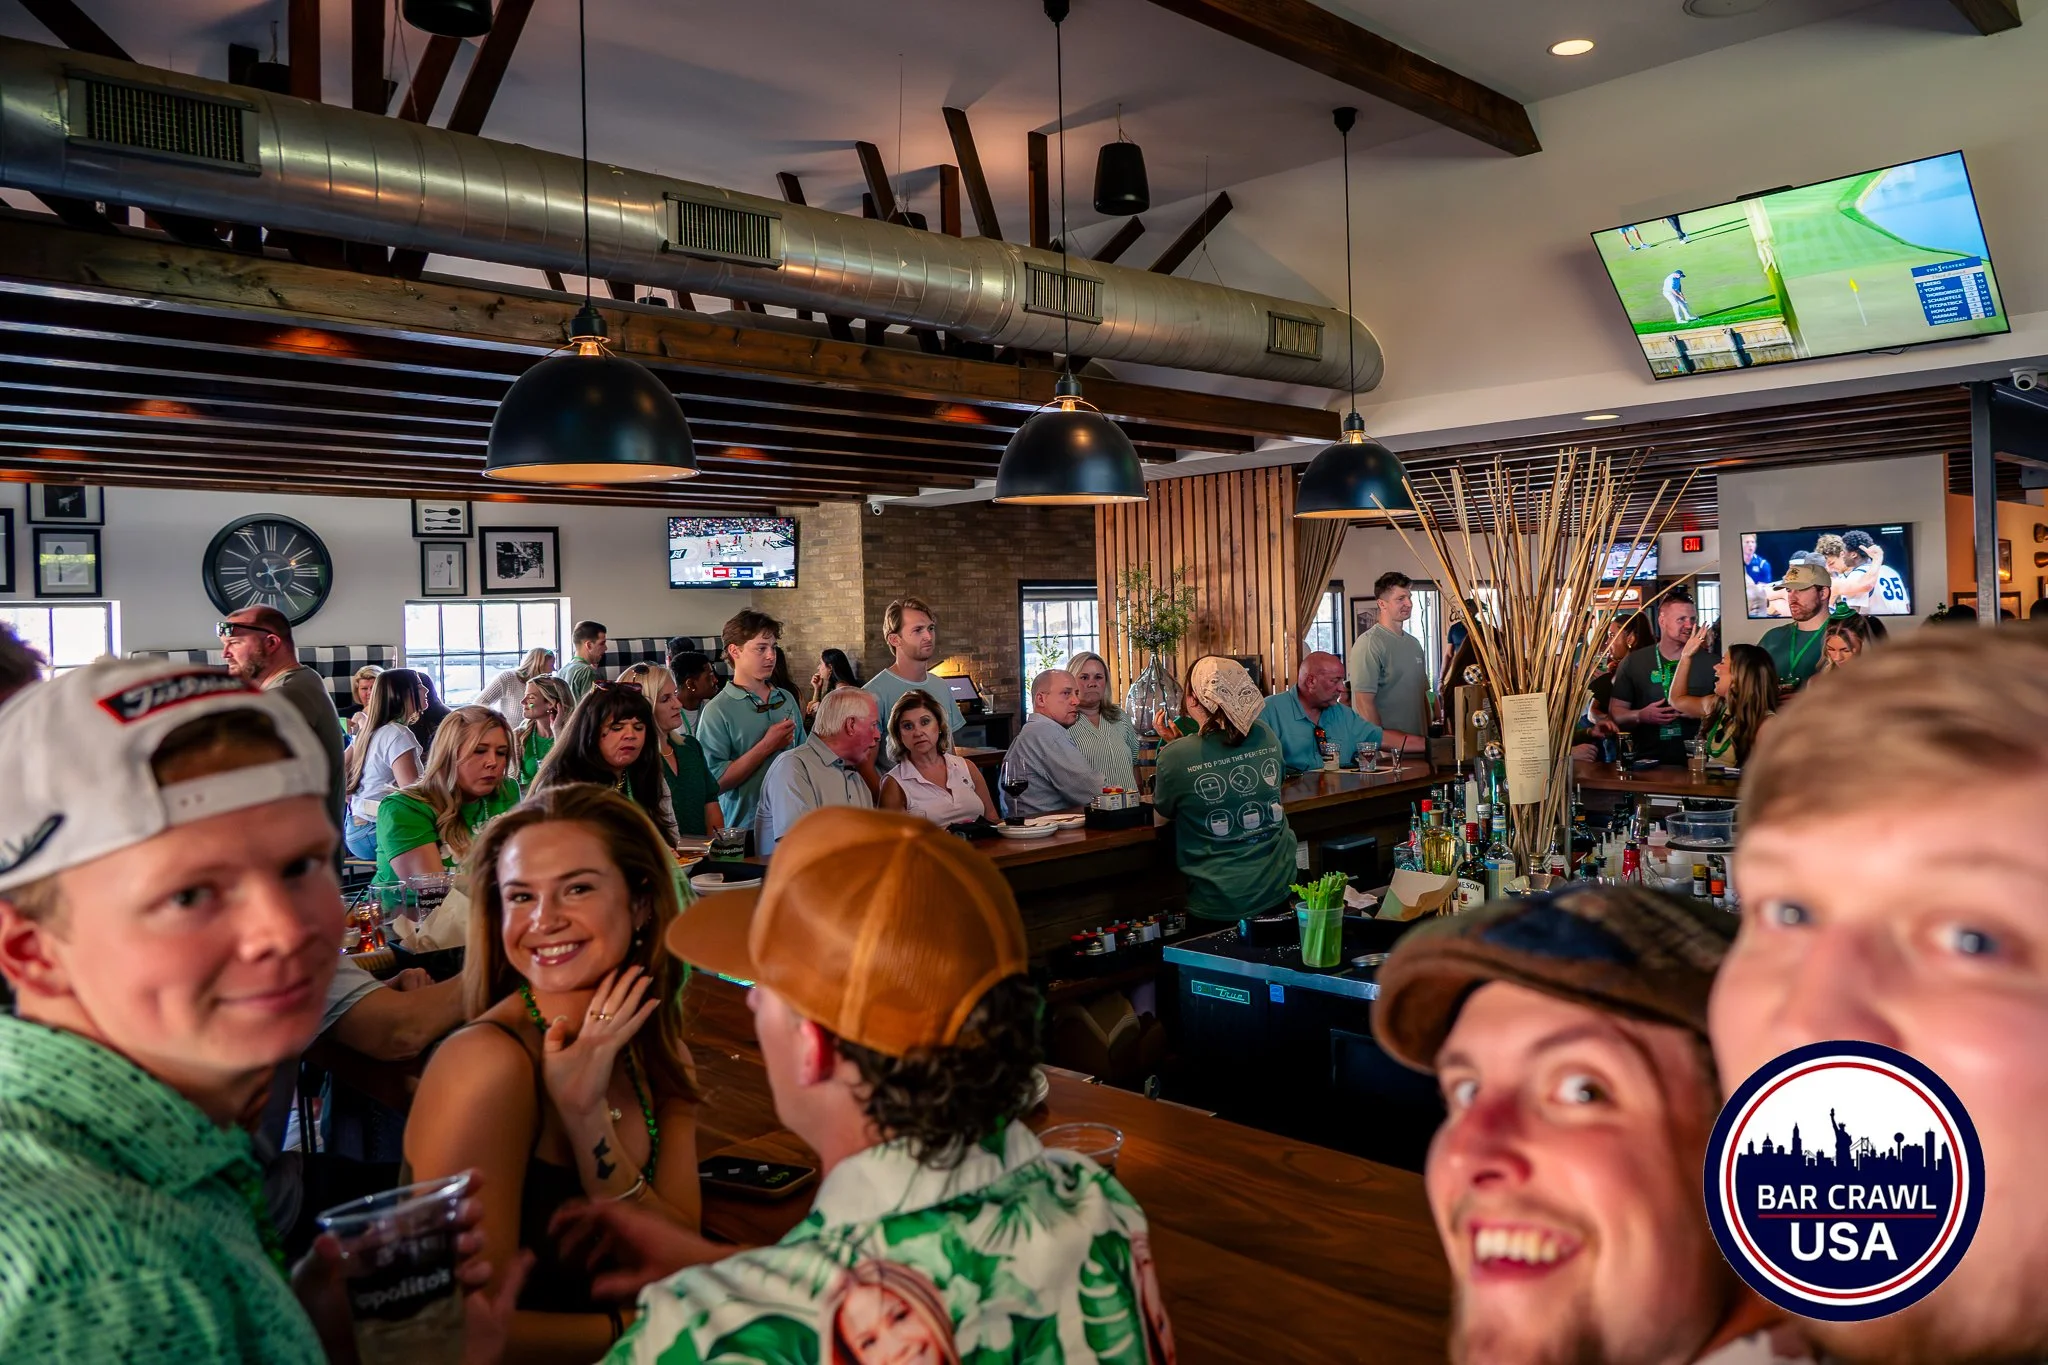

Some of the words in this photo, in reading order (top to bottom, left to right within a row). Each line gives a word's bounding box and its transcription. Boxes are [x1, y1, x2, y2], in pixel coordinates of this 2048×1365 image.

[1684, 538, 1700, 550] EXIT
[1880, 577, 1904, 600] 35
[1187, 765, 1203, 773] HOW
[1244, 748, 1268, 759] PERFECT
[1216, 987, 1245, 1002] True
